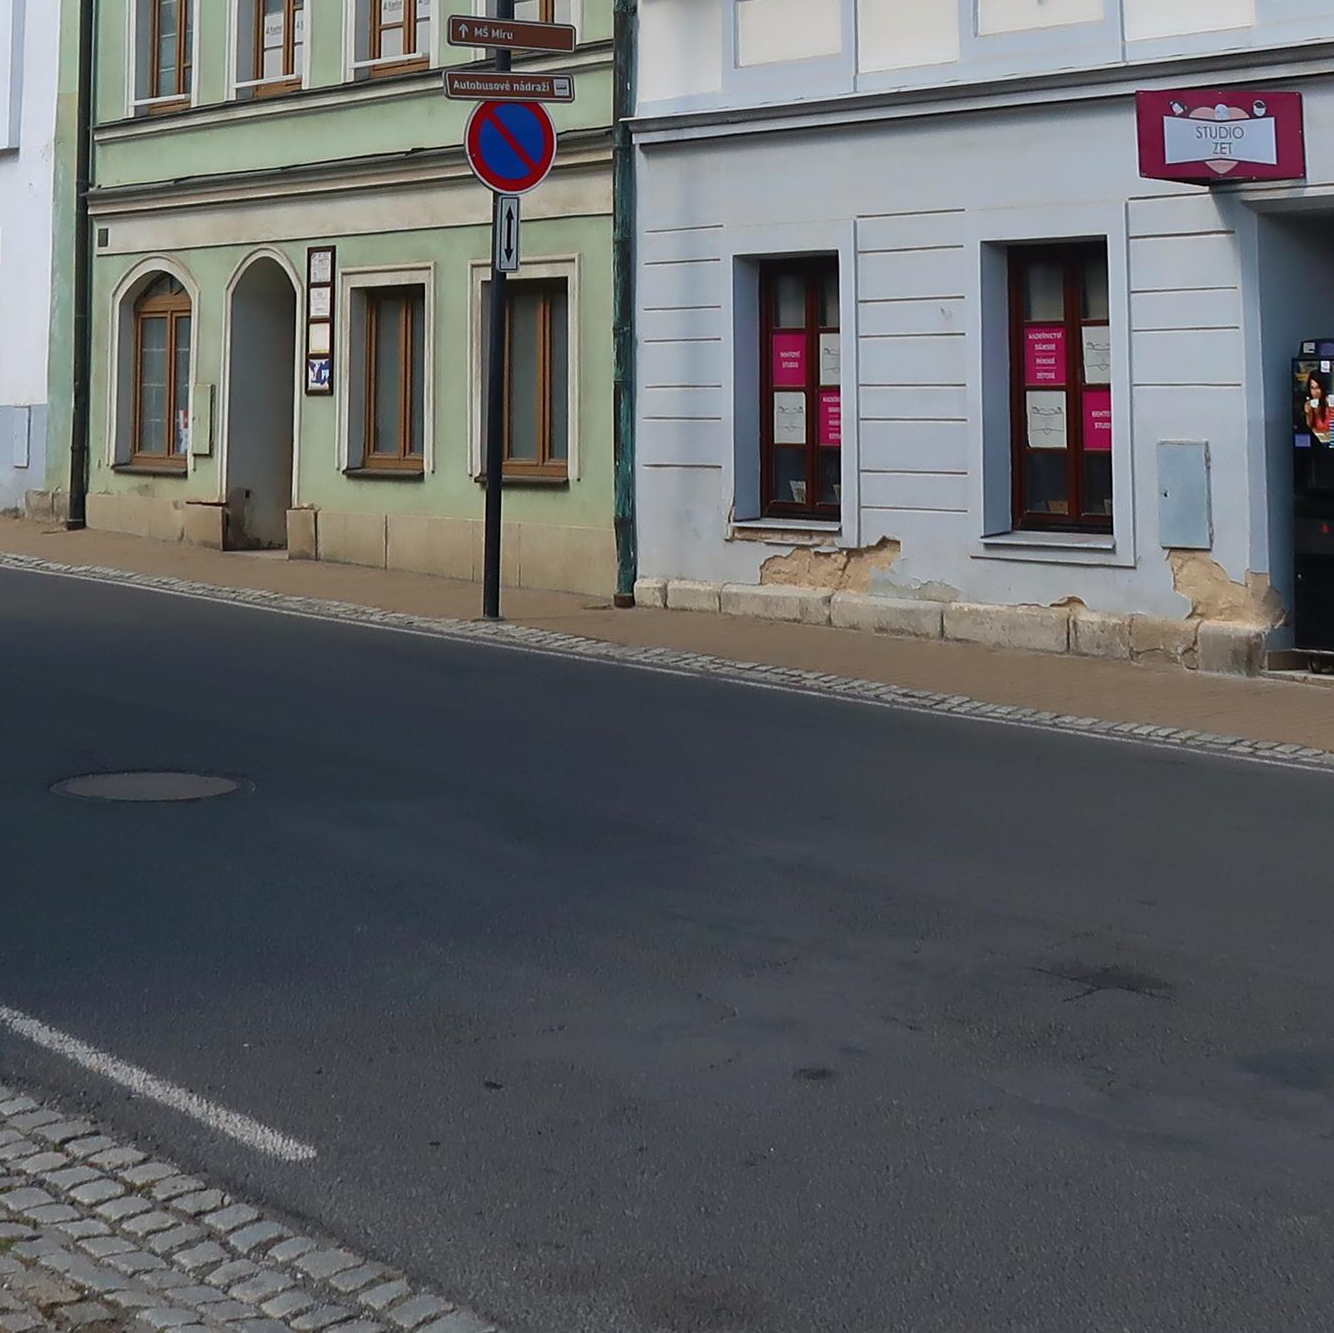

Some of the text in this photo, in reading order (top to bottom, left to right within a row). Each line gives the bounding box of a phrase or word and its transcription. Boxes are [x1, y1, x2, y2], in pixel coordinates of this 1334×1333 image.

[474, 26, 513, 40] MŠ Míru
[453, 79, 550, 92] Autobusové nádraží
[1195, 125, 1245, 140] STUDIO
[1212, 141, 1234, 155] ZET
